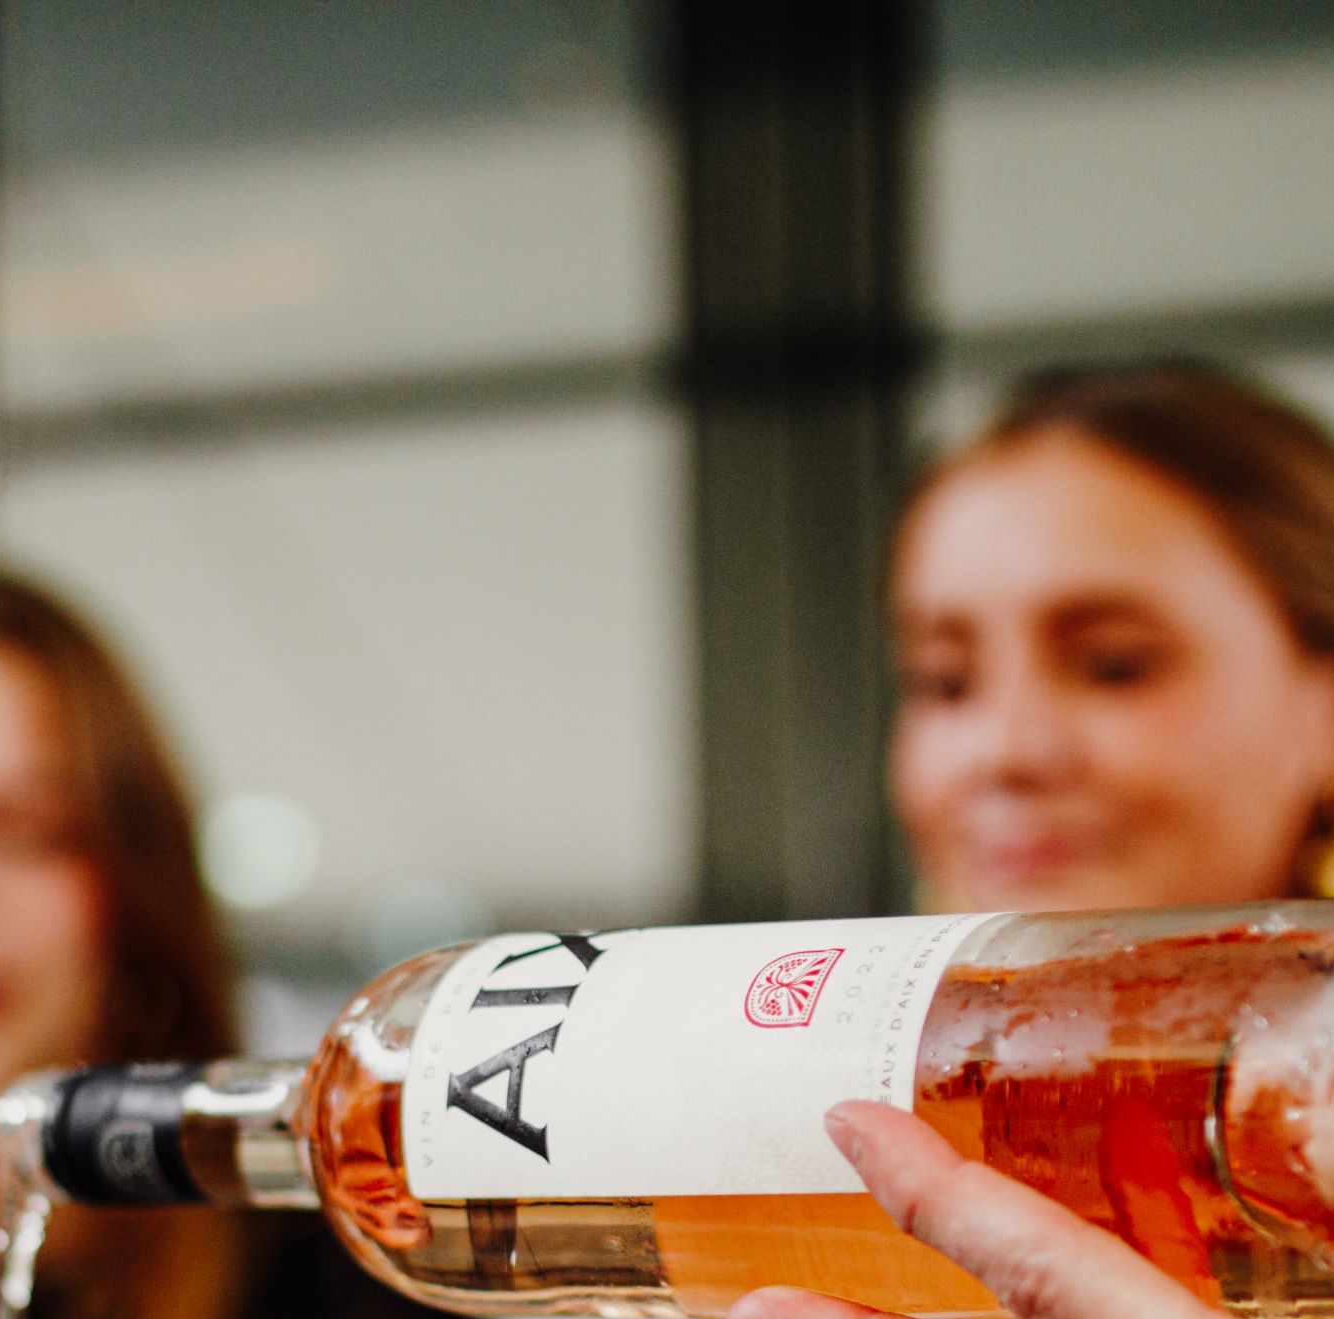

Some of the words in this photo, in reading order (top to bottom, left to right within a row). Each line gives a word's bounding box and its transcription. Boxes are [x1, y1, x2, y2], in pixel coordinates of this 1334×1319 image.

[837, 944, 887, 1024] 2022
[423, 1041, 443, 1079] DE
[447, 930, 609, 1164] AIX
[879, 1043, 897, 1104] EAUX
[890, 977, 919, 1031] D'AIX
[913, 948, 935, 970] EN
[420, 1110, 434, 1168] VIN
